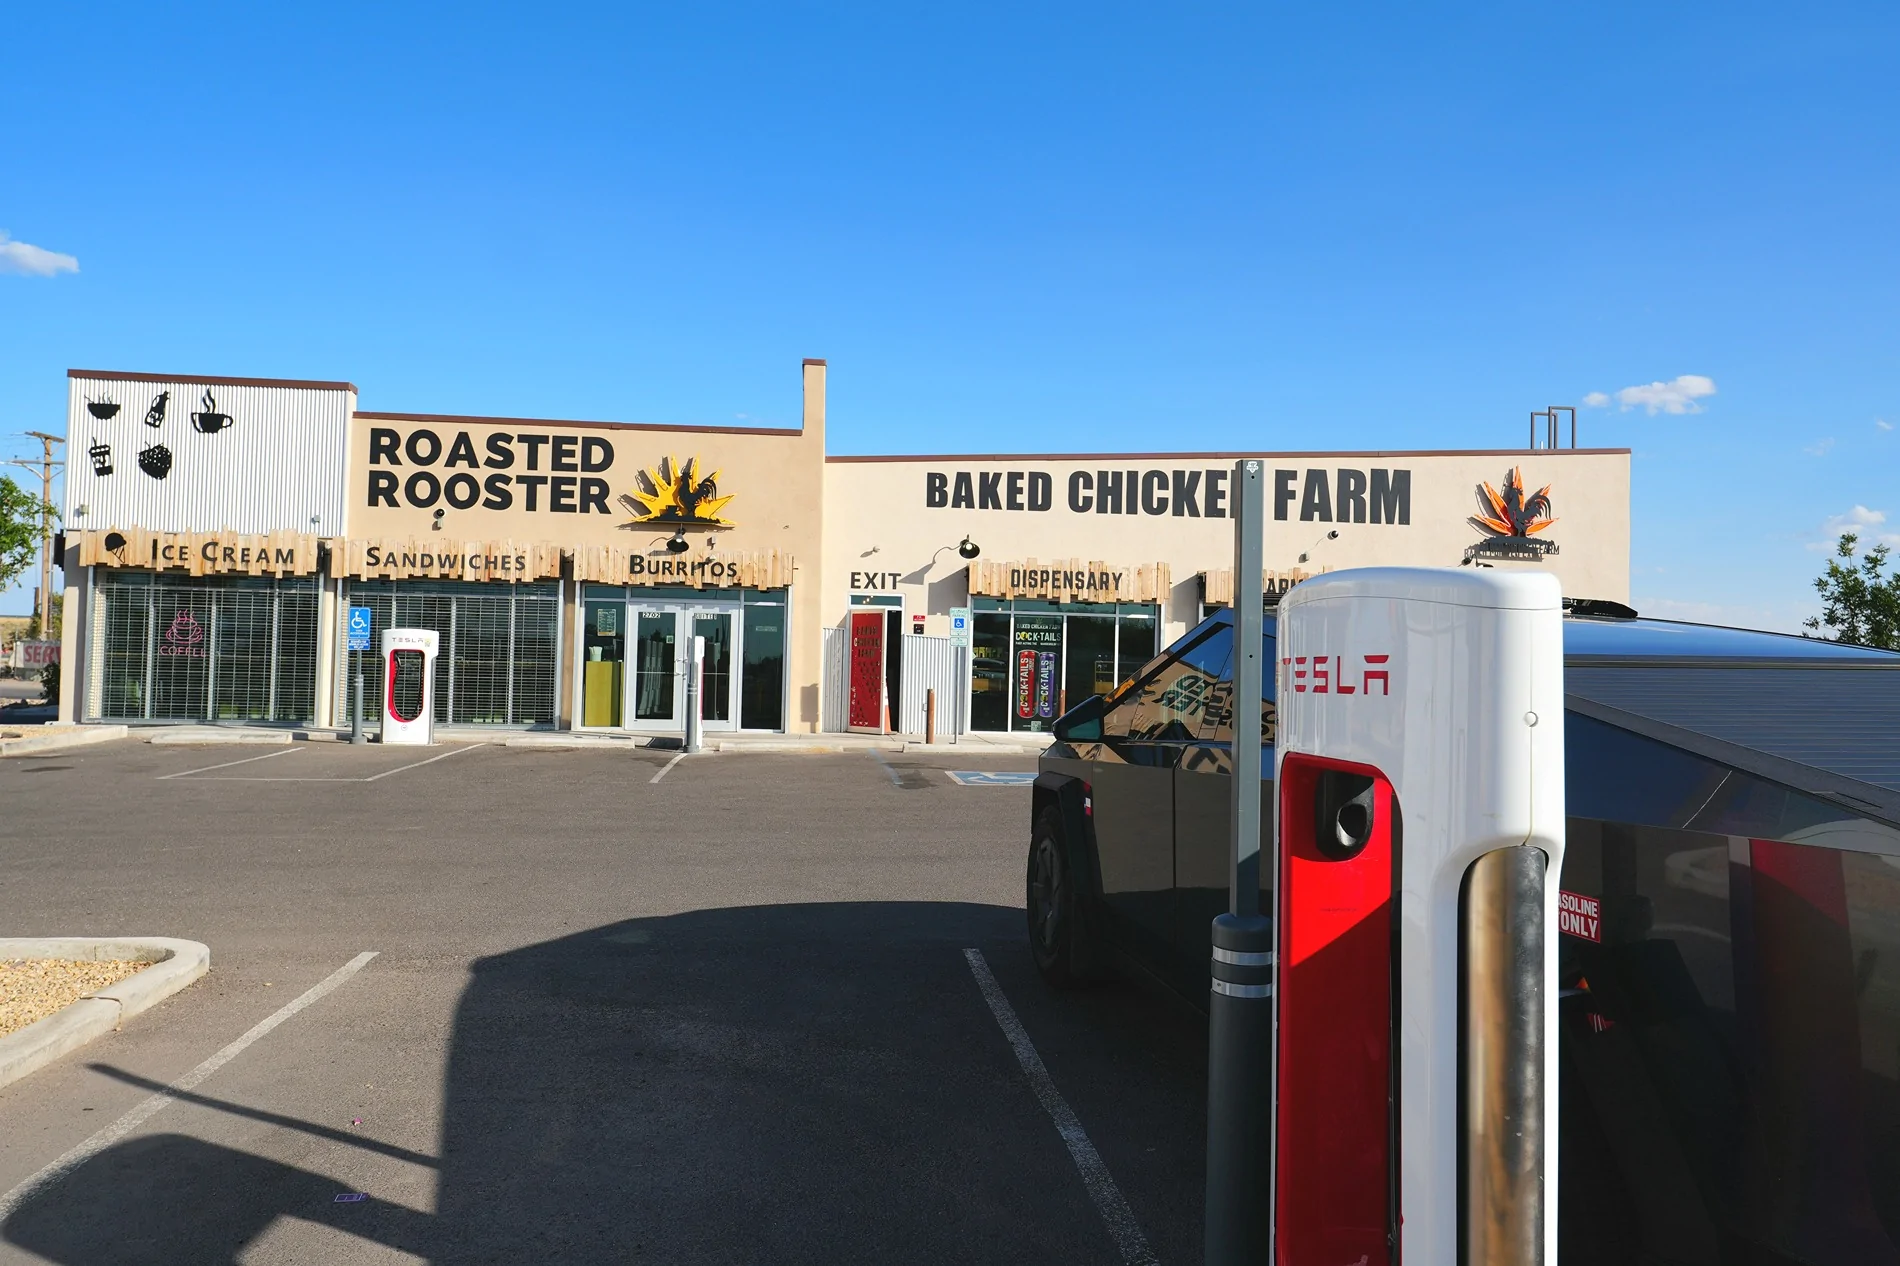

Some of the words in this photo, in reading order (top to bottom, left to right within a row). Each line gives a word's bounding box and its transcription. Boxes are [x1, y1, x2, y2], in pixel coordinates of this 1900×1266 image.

[369, 427, 614, 473] ROASTED
[367, 470, 611, 515] ROOSTER
[926, 471, 1053, 512] BAKED
[1068, 469, 1235, 518] CHICKE
[1274, 468, 1411, 525] FARM
[152, 539, 189, 561] ICE
[201, 541, 294, 564] CREAM
[366, 547, 526, 571] SANDWICHES
[629, 554, 737, 577] BURRITOS
[850, 572, 902, 590] EXIT
[1010, 569, 1122, 590] DISPENSARY
[1282, 654, 1389, 695] TESLA
[1558, 893, 1598, 918] ASOLINE
[1560, 910, 1598, 939] ONLY
